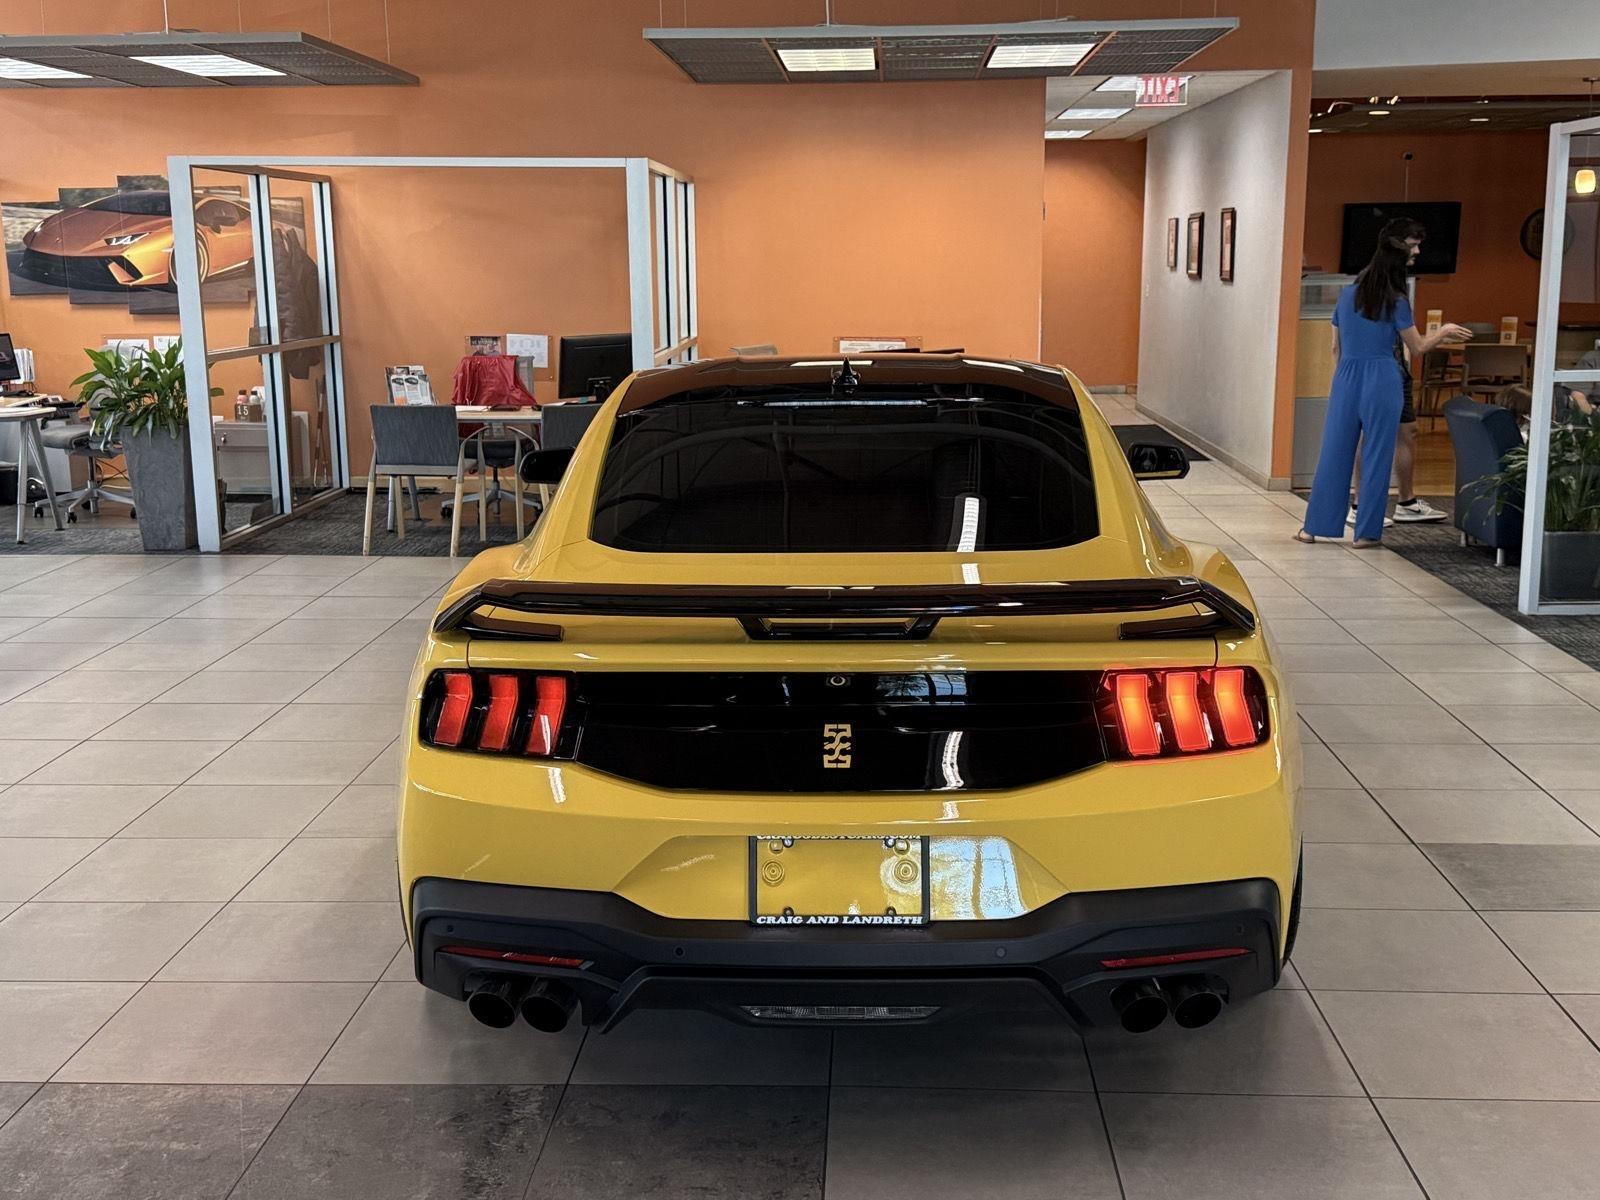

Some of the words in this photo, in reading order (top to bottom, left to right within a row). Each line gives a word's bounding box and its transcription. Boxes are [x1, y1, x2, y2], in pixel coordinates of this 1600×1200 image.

[237, 405, 249, 416] 15
[756, 916, 803, 925] CRAIG
[805, 916, 839, 925] AND
[842, 916, 923, 925] LANDRETH
